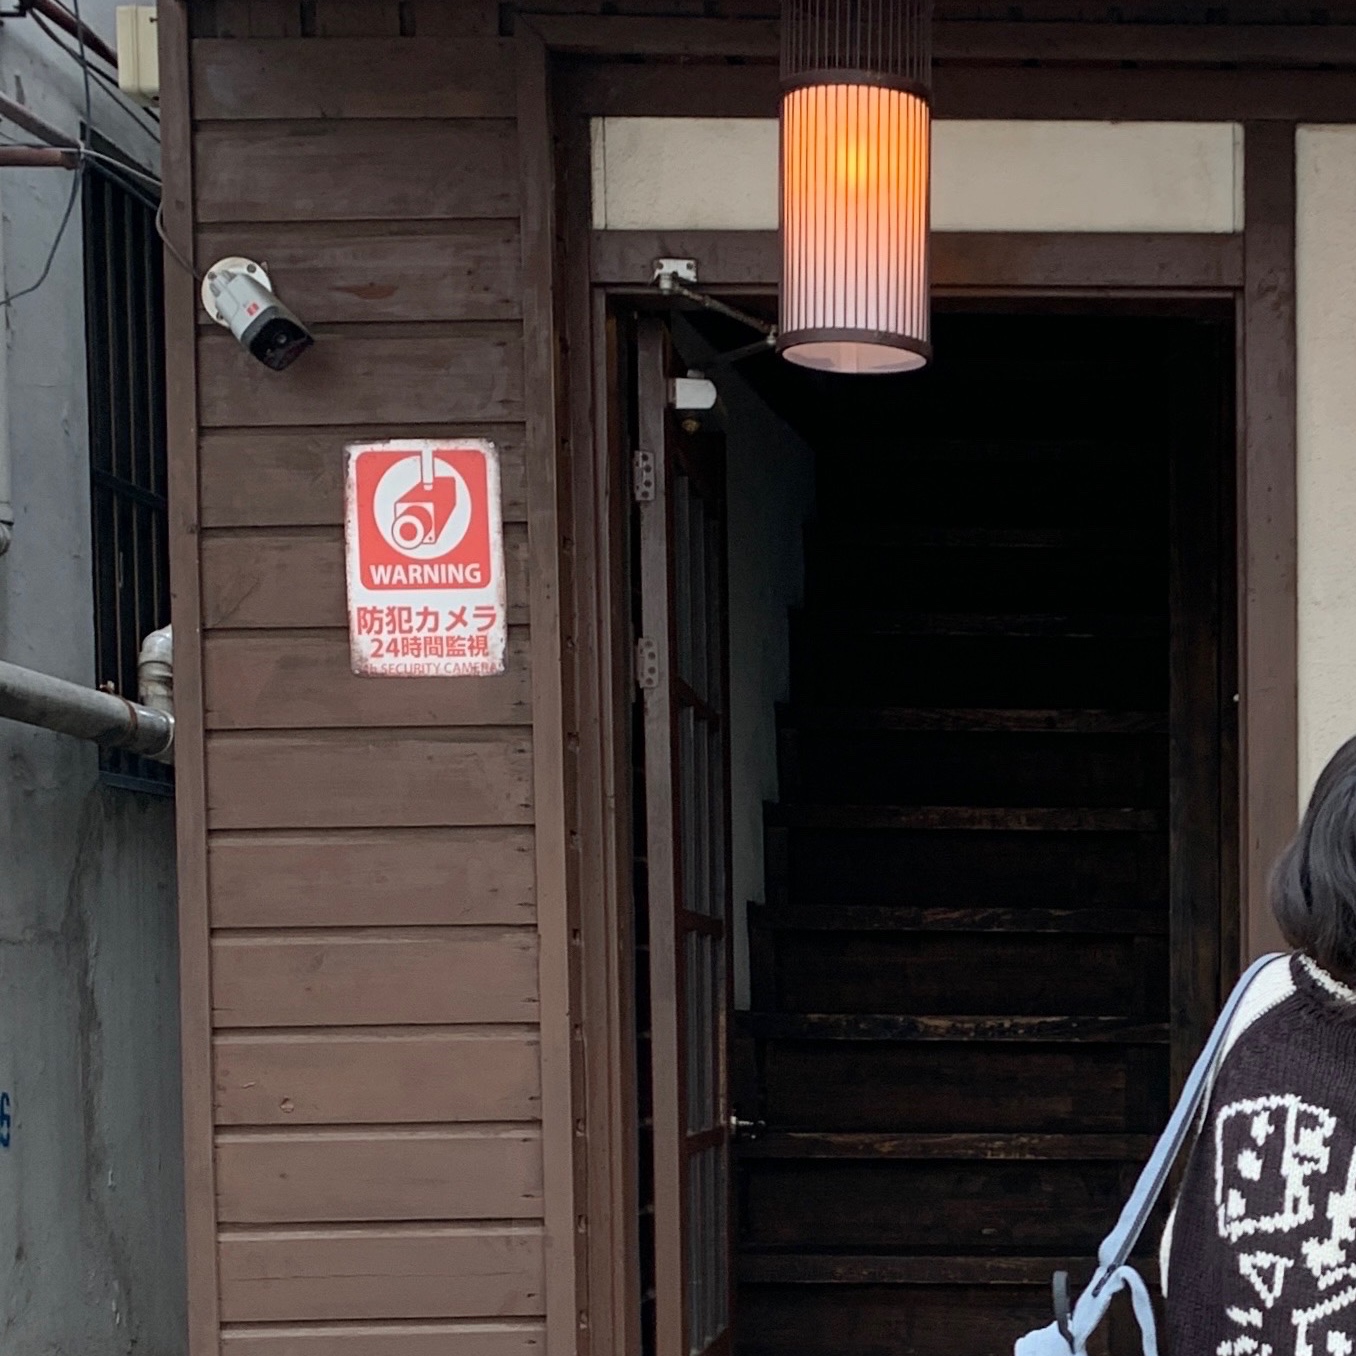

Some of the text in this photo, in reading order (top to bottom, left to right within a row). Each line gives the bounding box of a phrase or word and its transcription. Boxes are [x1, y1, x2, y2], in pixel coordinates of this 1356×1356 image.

[369, 563, 482, 585] WARNING
[356, 605, 497, 635] 防犯カメラ
[370, 635, 490, 659] 24時間監視
[381, 662, 441, 675] SECURITY
